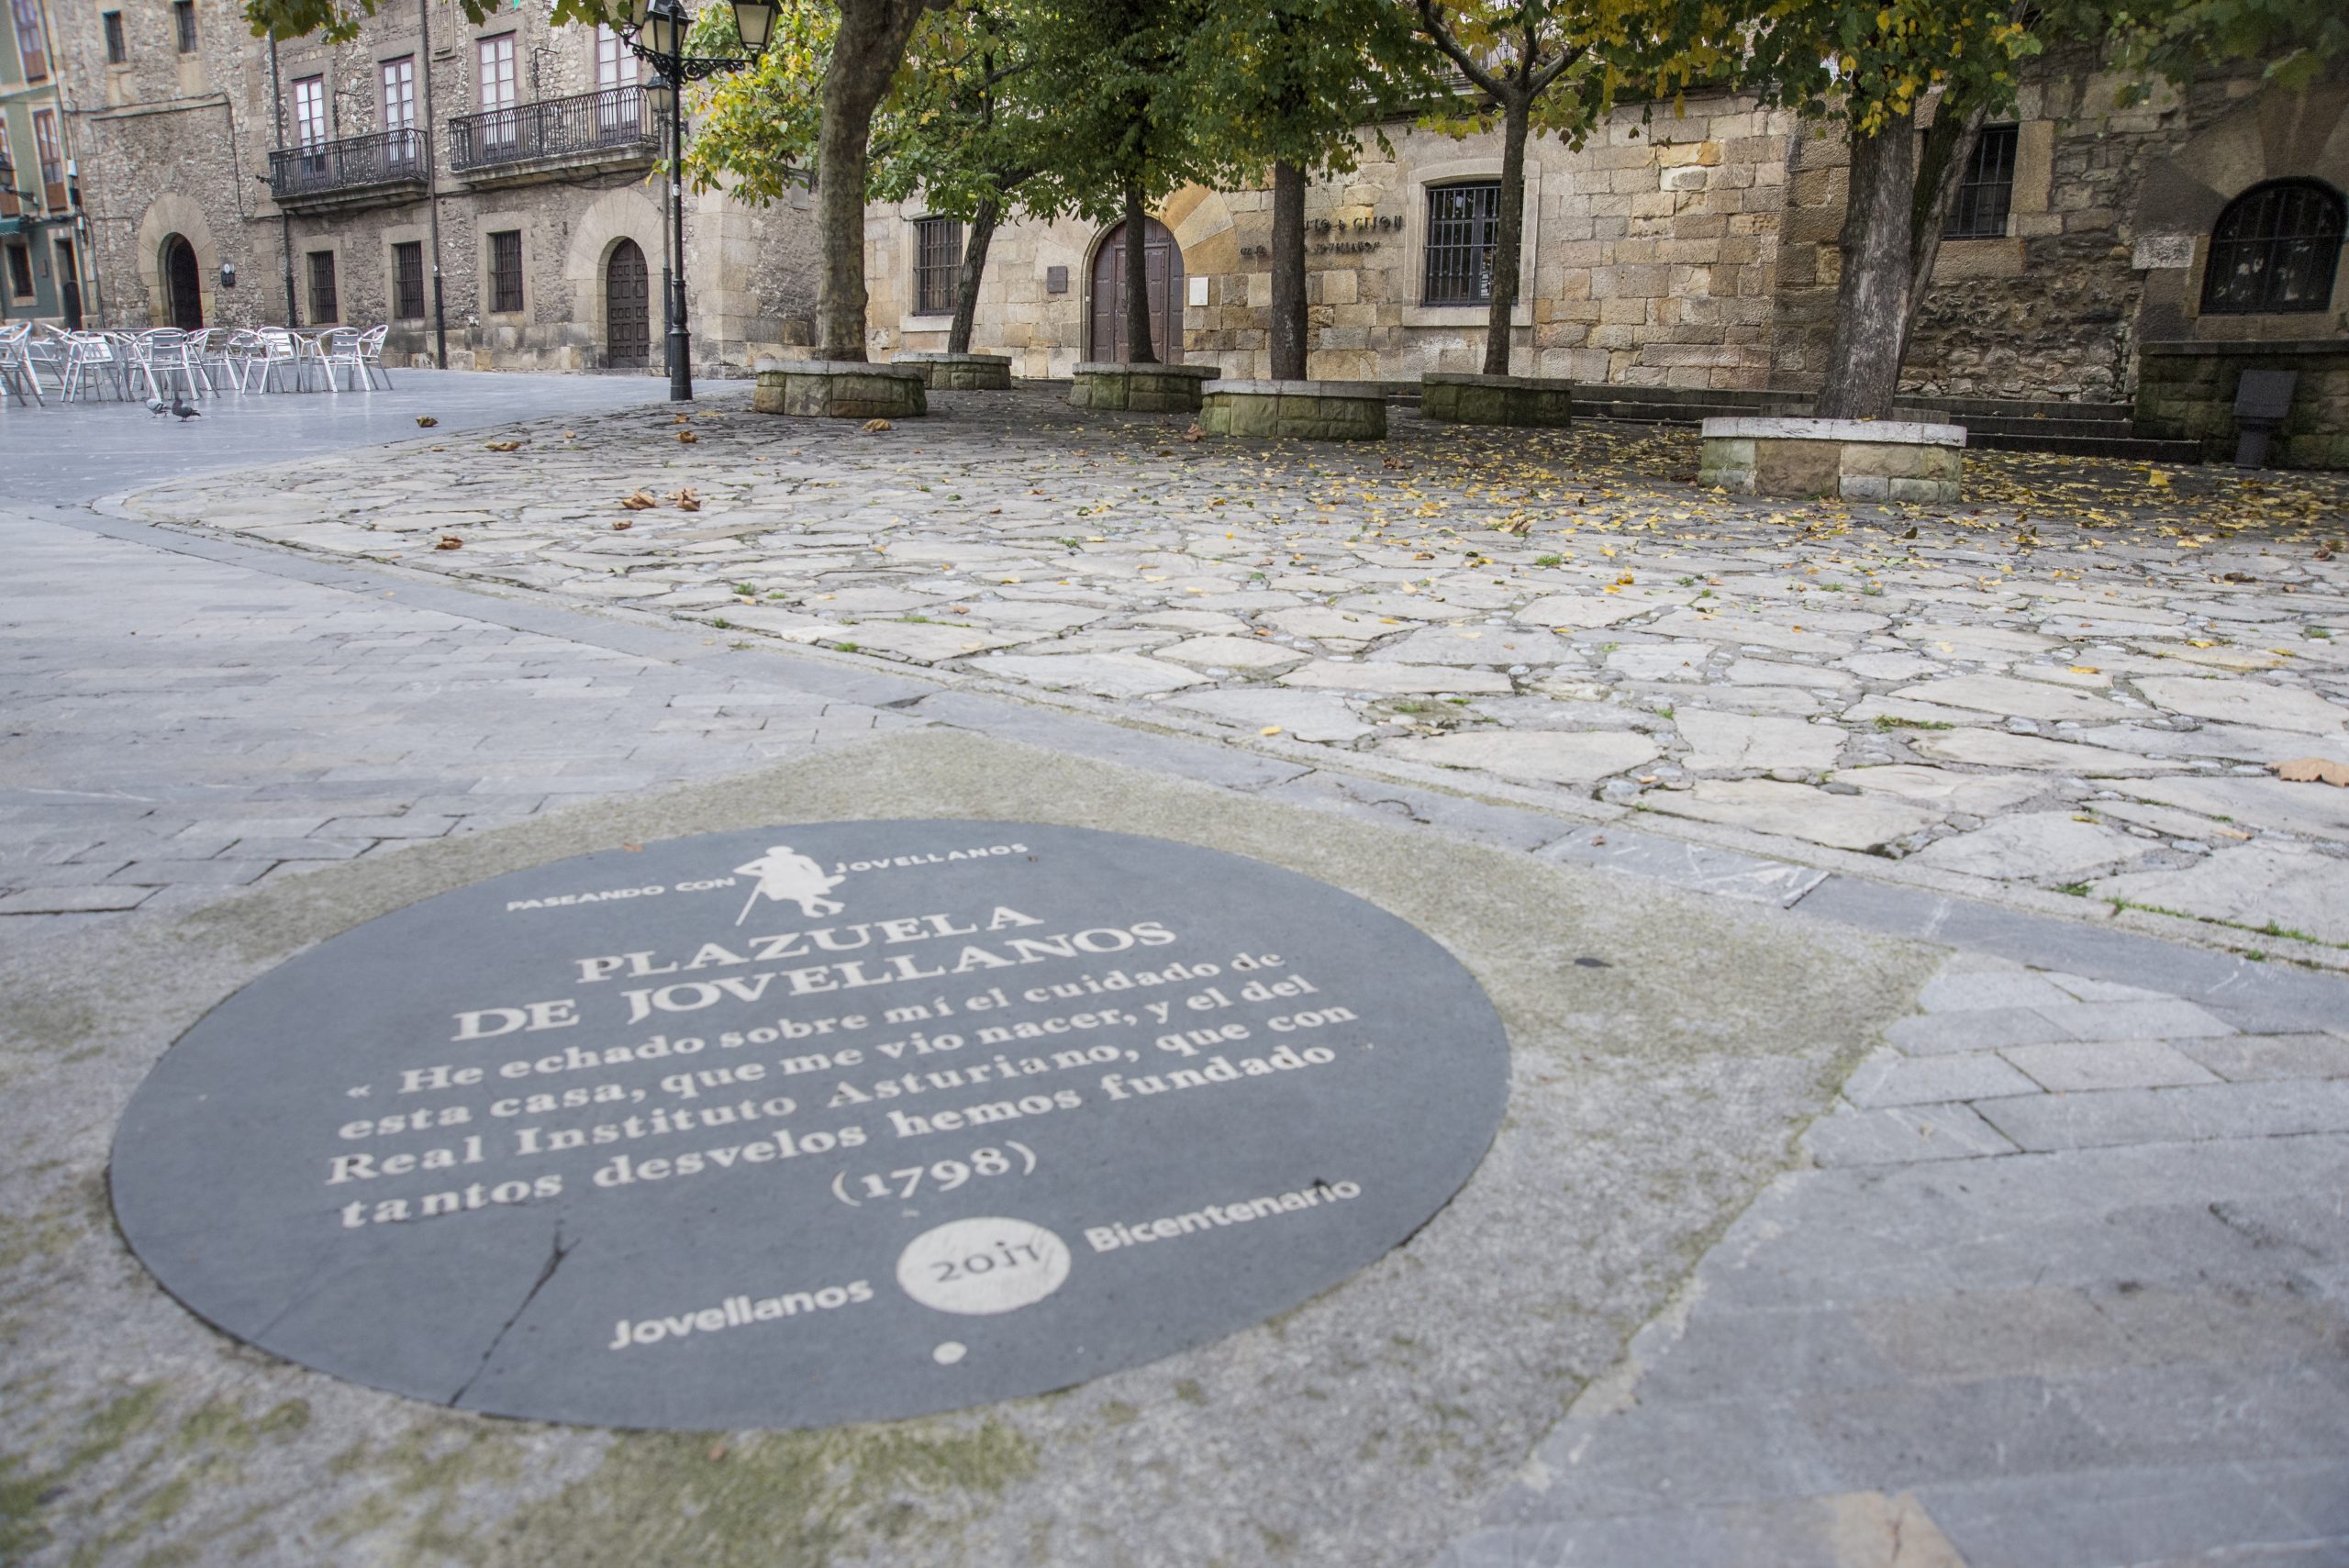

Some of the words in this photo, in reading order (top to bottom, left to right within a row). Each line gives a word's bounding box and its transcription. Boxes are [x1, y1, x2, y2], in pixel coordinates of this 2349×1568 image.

[506, 885, 665, 912] PASEANDO
[674, 876, 737, 893] CON
[834, 841, 1030, 873] JOVELLANOS
[574, 903, 1046, 984] PLAZUELA
[398, 1064, 484, 1094] He
[498, 1034, 706, 1079] echado
[718, 1015, 870, 1049] sobre
[964, 986, 1013, 1012] el
[1022, 962, 1222, 1003] cuidado
[1230, 949, 1286, 973] de
[451, 997, 581, 1041] DE
[619, 921, 1178, 1026] JOVELLANOS
[325, 1135, 484, 1185] Real
[515, 1096, 797, 1155] Instituto
[827, 1044, 1141, 1108] Asturiano,
[1154, 1023, 1252, 1058] que
[1266, 1006, 1359, 1033] con
[340, 1105, 473, 1140] esta
[489, 1083, 647, 1118] casa,
[660, 1062, 767, 1100] que
[778, 1048, 864, 1075] me
[874, 1031, 965, 1060] vio
[974, 1008, 1139, 1045] nacer,
[1142, 1000, 1170, 1025] y
[1186, 985, 1235, 1011] el
[1240, 973, 1320, 1003] del
[341, 1173, 562, 1229] tantos
[593, 1125, 868, 1187] desvelos
[885, 1089, 1083, 1139] hemos
[1099, 1043, 1336, 1101] fundado
[831, 1140, 1038, 1207] (1798)
[608, 1279, 874, 1351] Jovellanos
[1084, 1177, 1362, 1253] Bicentenario
